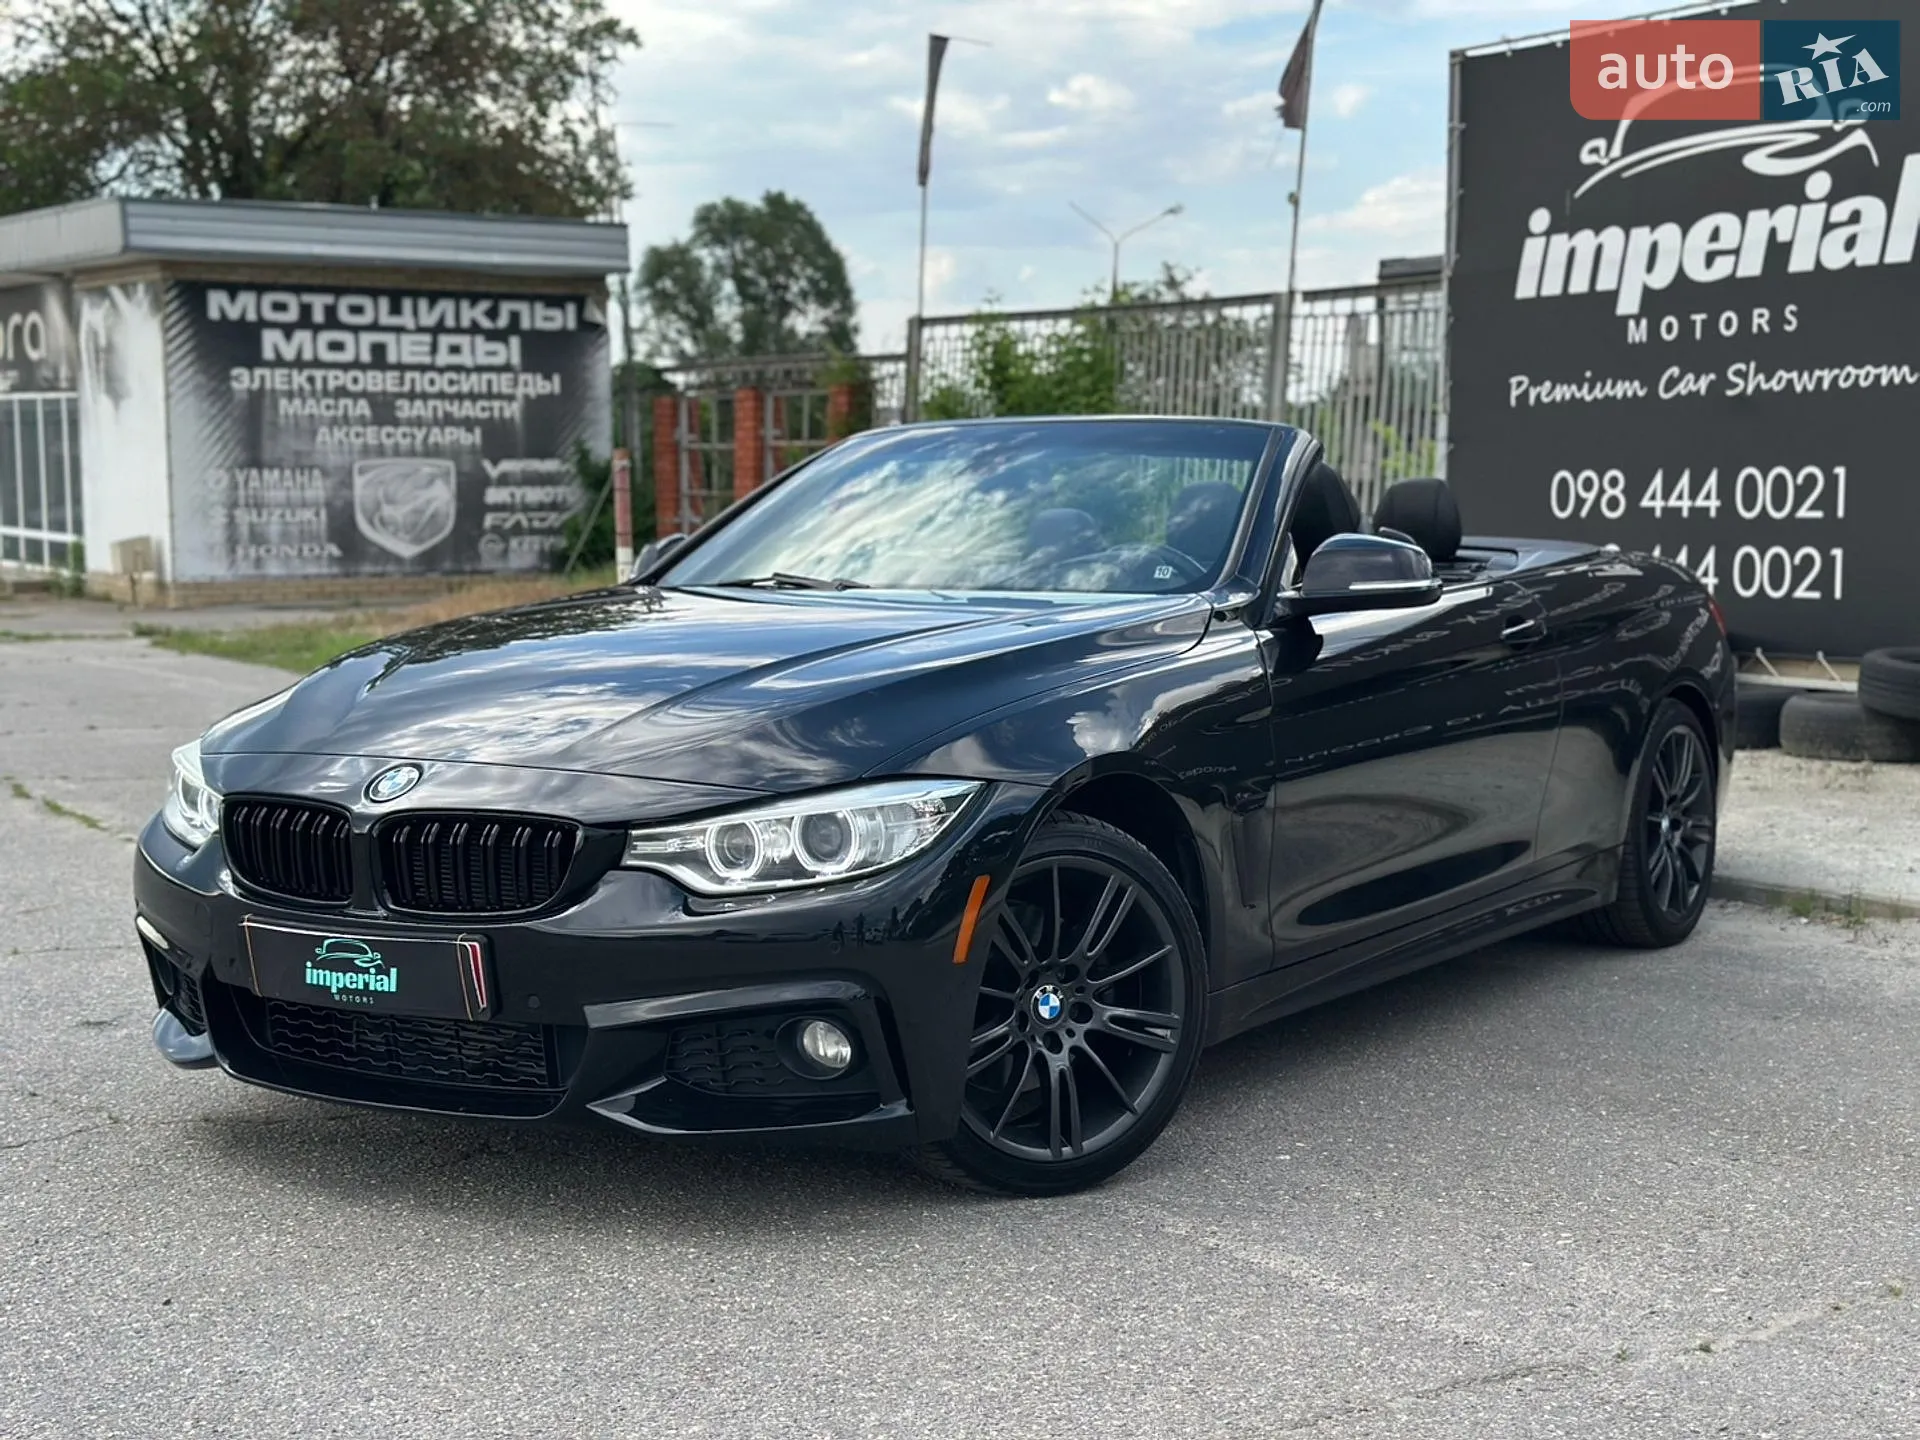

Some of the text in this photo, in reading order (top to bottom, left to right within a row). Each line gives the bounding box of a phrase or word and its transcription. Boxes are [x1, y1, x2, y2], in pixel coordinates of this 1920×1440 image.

[1515, 153, 1920, 316] imperial
[206, 288, 578, 331] МОТОЦИКЛЫ
[1626, 304, 1799, 344] MOTORS
[0, 311, 47, 361] ra
[261, 328, 522, 368] МОПЕДЫ
[229, 366, 562, 399] ЭЛЕКТРОВЕЛОСИПЕДЫ
[1508, 361, 1918, 407] Premium Car Showroom
[278, 398, 522, 420] МАСЛА ЗАПЧАСТИ
[315, 424, 482, 447] АКСЕССУАРЫ
[235, 468, 322, 490] YAMAHA
[1550, 465, 1847, 519] 098 444 0021
[235, 543, 343, 557] HONDA
[1732, 545, 1844, 600] 0021
[305, 961, 397, 993] imperial
